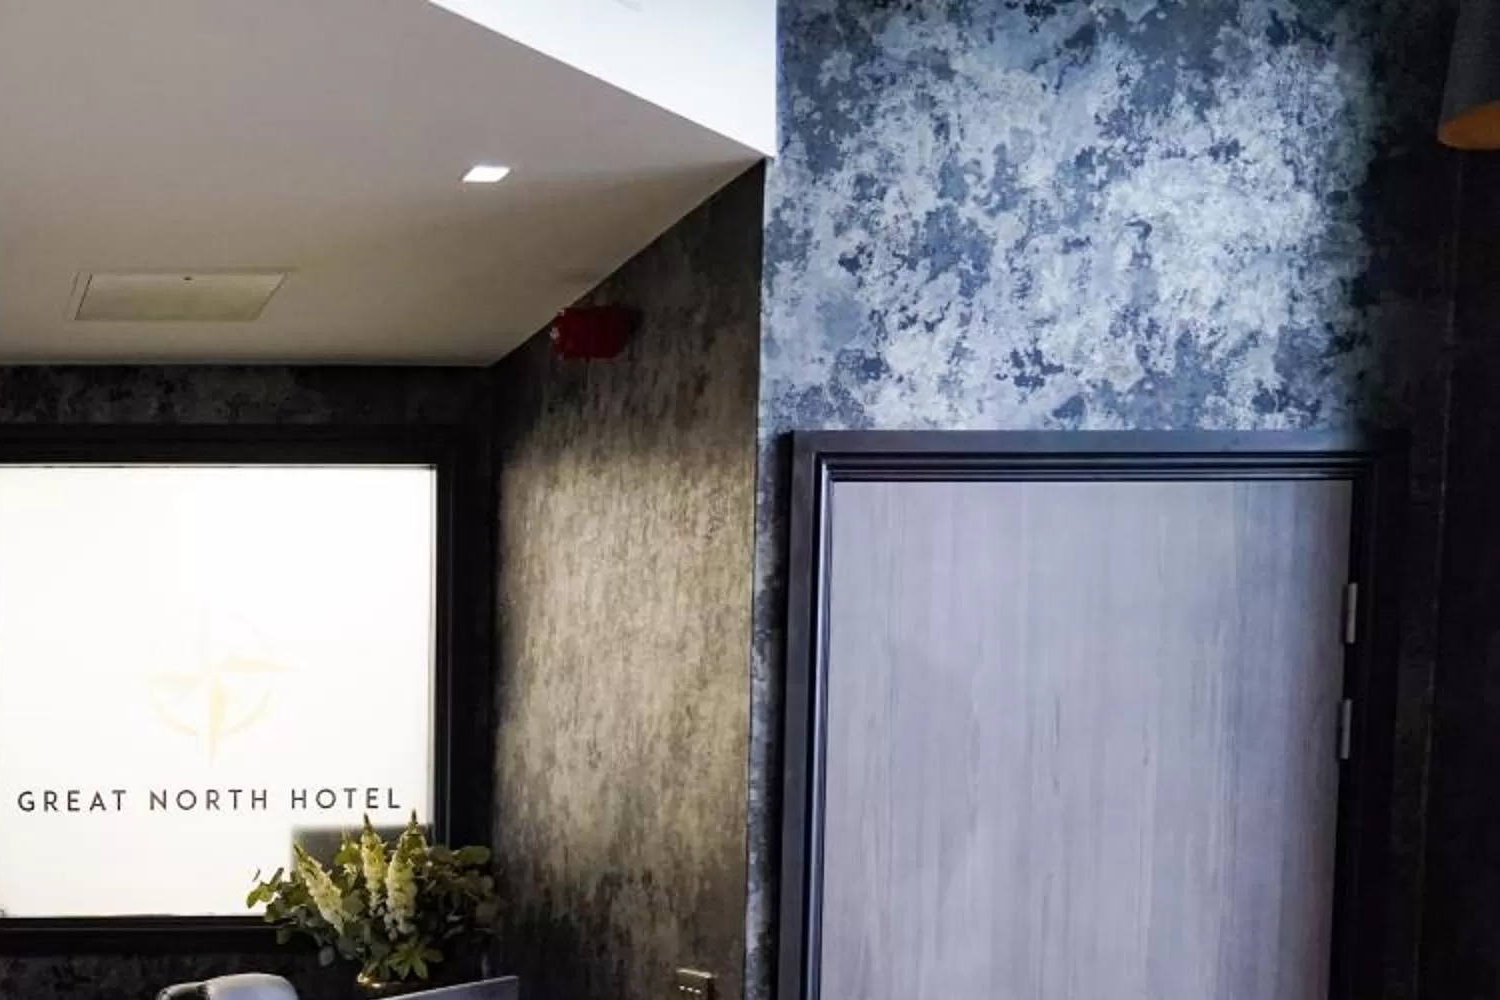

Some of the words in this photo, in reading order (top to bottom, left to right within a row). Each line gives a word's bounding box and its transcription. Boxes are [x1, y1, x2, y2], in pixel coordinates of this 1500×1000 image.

[17, 789, 127, 813] GREAT
[149, 788, 268, 811] NORTH
[291, 787, 401, 810] HOTEL
